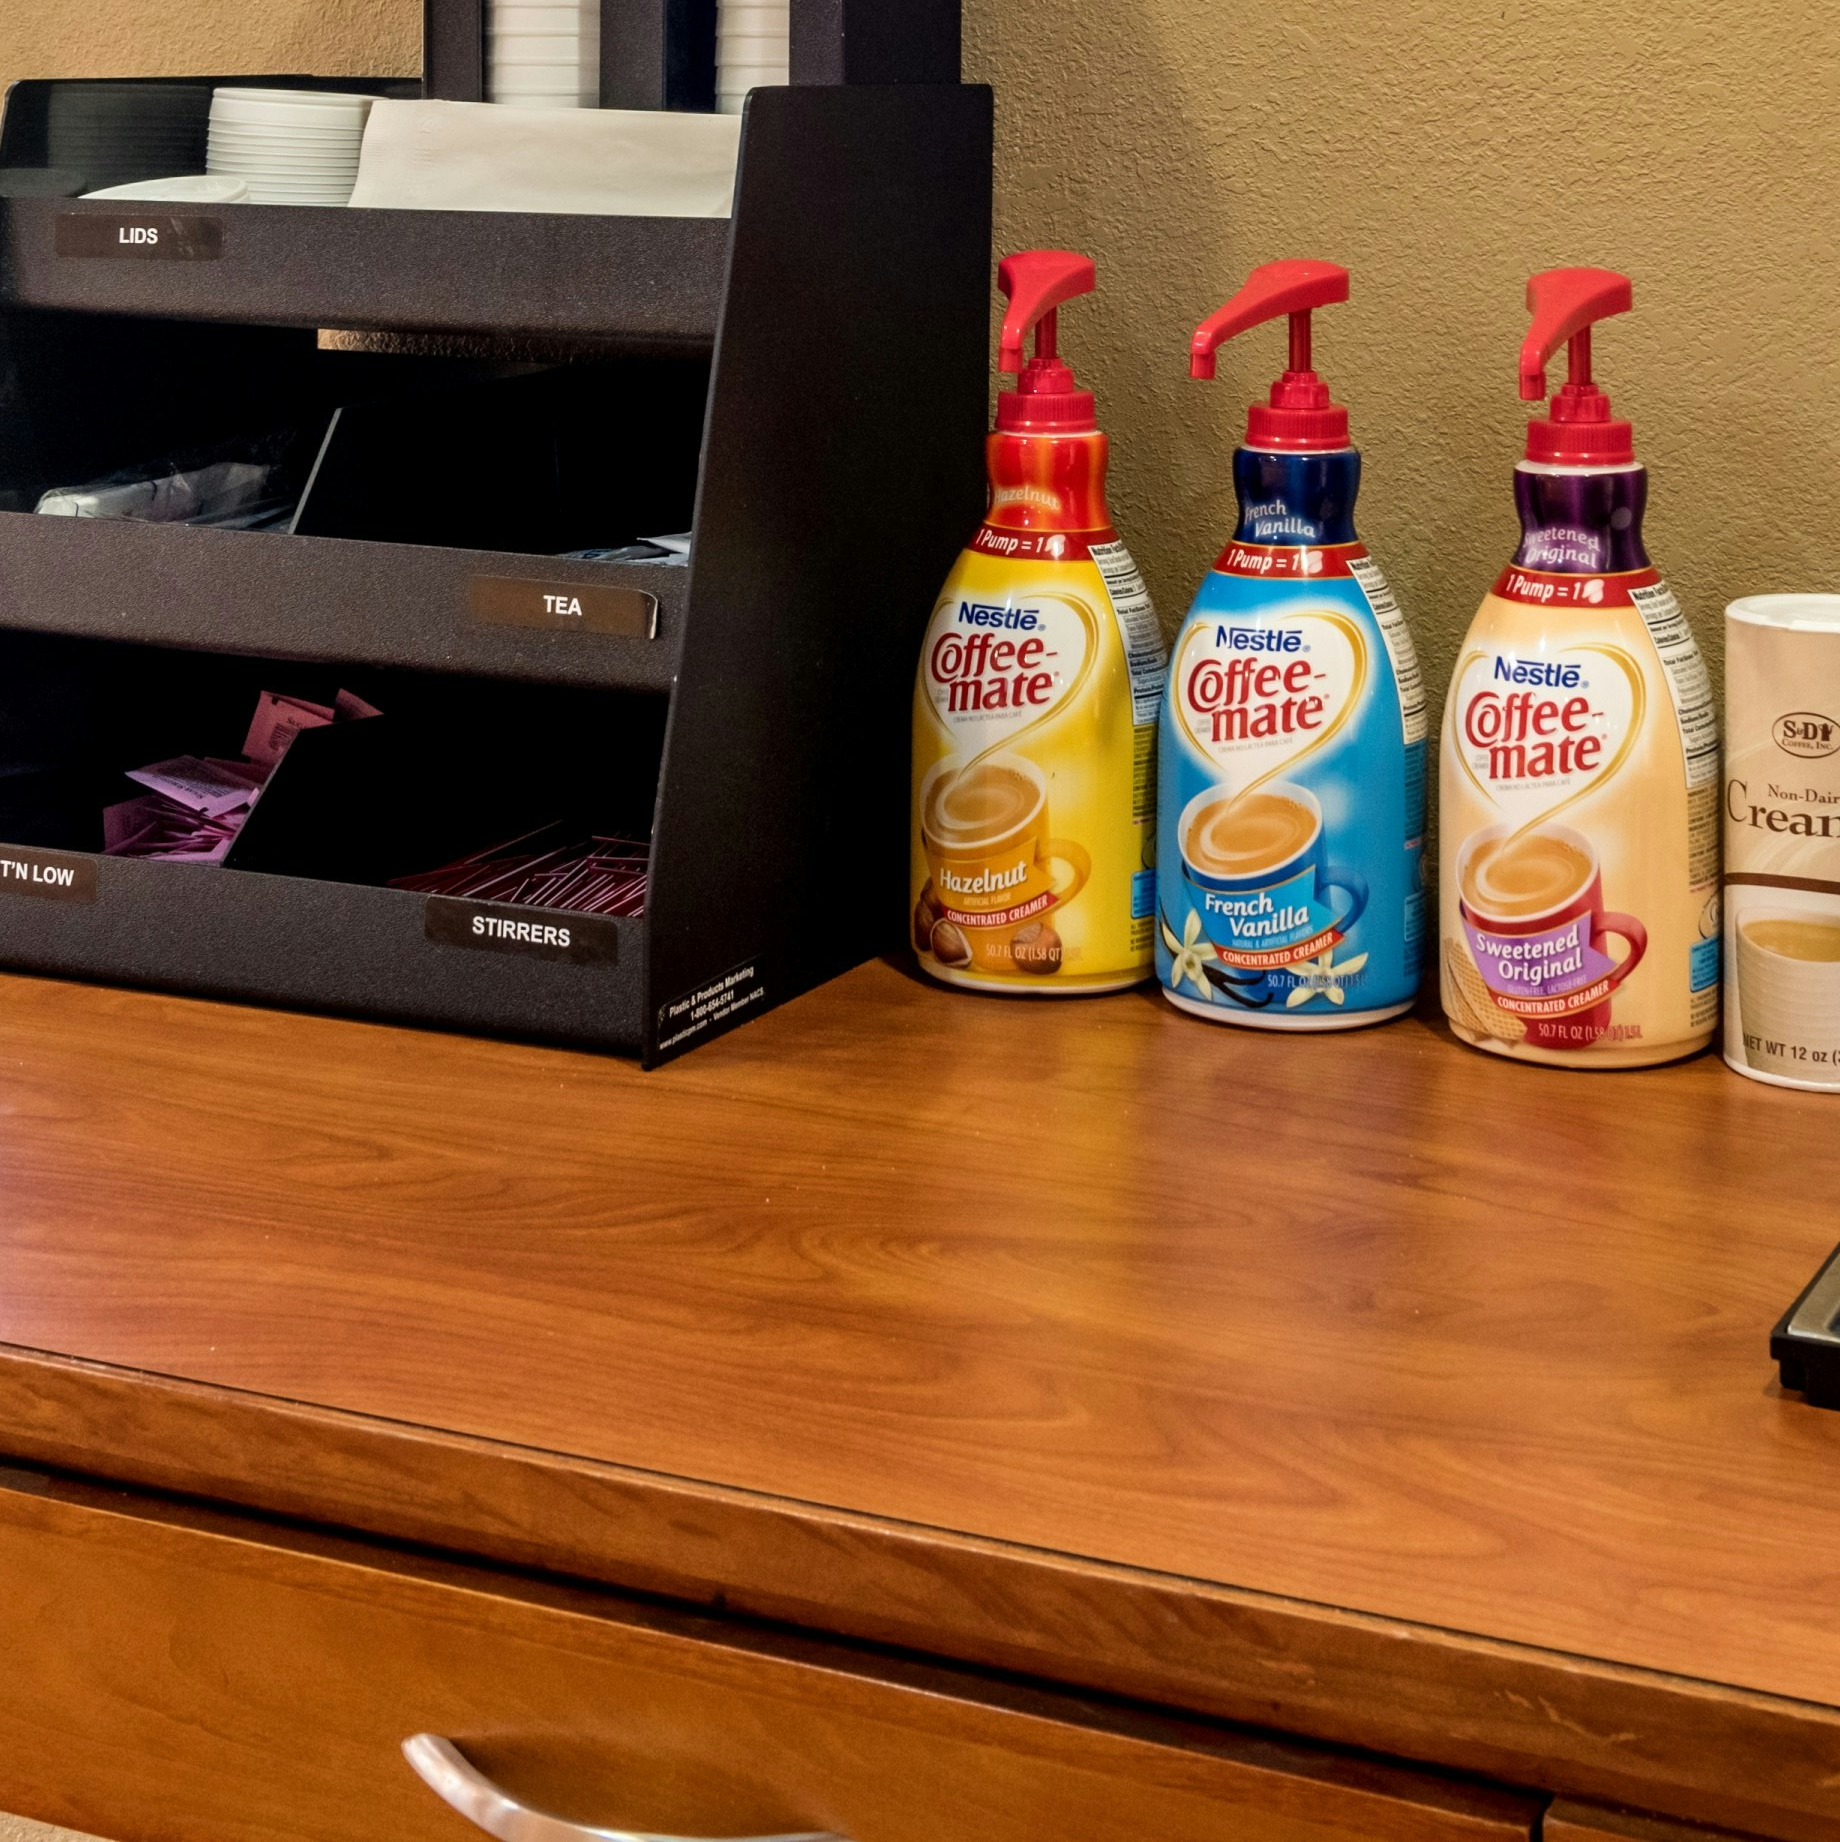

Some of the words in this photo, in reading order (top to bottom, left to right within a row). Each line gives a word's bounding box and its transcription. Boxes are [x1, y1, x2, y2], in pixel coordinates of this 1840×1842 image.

[119, 227, 158, 244] LIDS
[994, 486, 1060, 510] Hazelnut
[1244, 499, 1286, 525] French
[975, 528, 984, 544] 1
[983, 531, 1019, 555] Pump
[1036, 537, 1044, 553] 1
[1254, 518, 1316, 538] Vanilla
[1523, 526, 1600, 552] Sweetened
[1227, 549, 1236, 565] 1
[1234, 550, 1273, 574] Pump
[1292, 553, 1300, 570] 1
[1525, 544, 1599, 568] Original
[1506, 574, 1515, 591] 1
[1513, 575, 1554, 603] Pump
[1573, 582, 1582, 600] 1
[543, 595, 583, 616] TEA
[948, 671, 1053, 712] mate
[1211, 695, 1324, 742] mate
[1783, 720, 1818, 742] S&D
[1489, 734, 1601, 779] mate
[33, 865, 74, 887] LOW
[940, 860, 1027, 894] Hazelnut
[947, 910, 1007, 926] CONCENTRATED
[1009, 894, 1048, 921] CREAMER
[1205, 892, 1274, 916] French
[472, 916, 571, 947] STIRRERS
[1229, 905, 1309, 938] Vanilla
[986, 944, 1002, 958] 50.7
[1015, 946, 1027, 958] OZ
[1028, 946, 1047, 961] (1.58
[1223, 951, 1291, 965] CONCENTRATED
[1293, 932, 1333, 960] CREAMER
[1476, 924, 1579, 960] Sweetened
[1267, 974, 1285, 988] 50.7
[1286, 974, 1297, 988] FL
[1498, 949, 1583, 986] Original
[669, 999, 690, 1018] Plastic
[697, 982, 724, 1003] Products
[725, 966, 754, 988] Marketing
[1497, 995, 1565, 1013] CONCENTRATED
[1568, 980, 1609, 1008] CREAMER
[1539, 1024, 1557, 1038] 50.7
[1558, 1024, 1569, 1038] FL
[1571, 1025, 1583, 1039] OZ
[1585, 1025, 1605, 1041] (1.58
[1743, 1033, 1762, 1051] NET
[1766, 1040, 1787, 1057] WT
[1791, 1047, 1807, 1060] 12
[1812, 1051, 1827, 1062] oz
